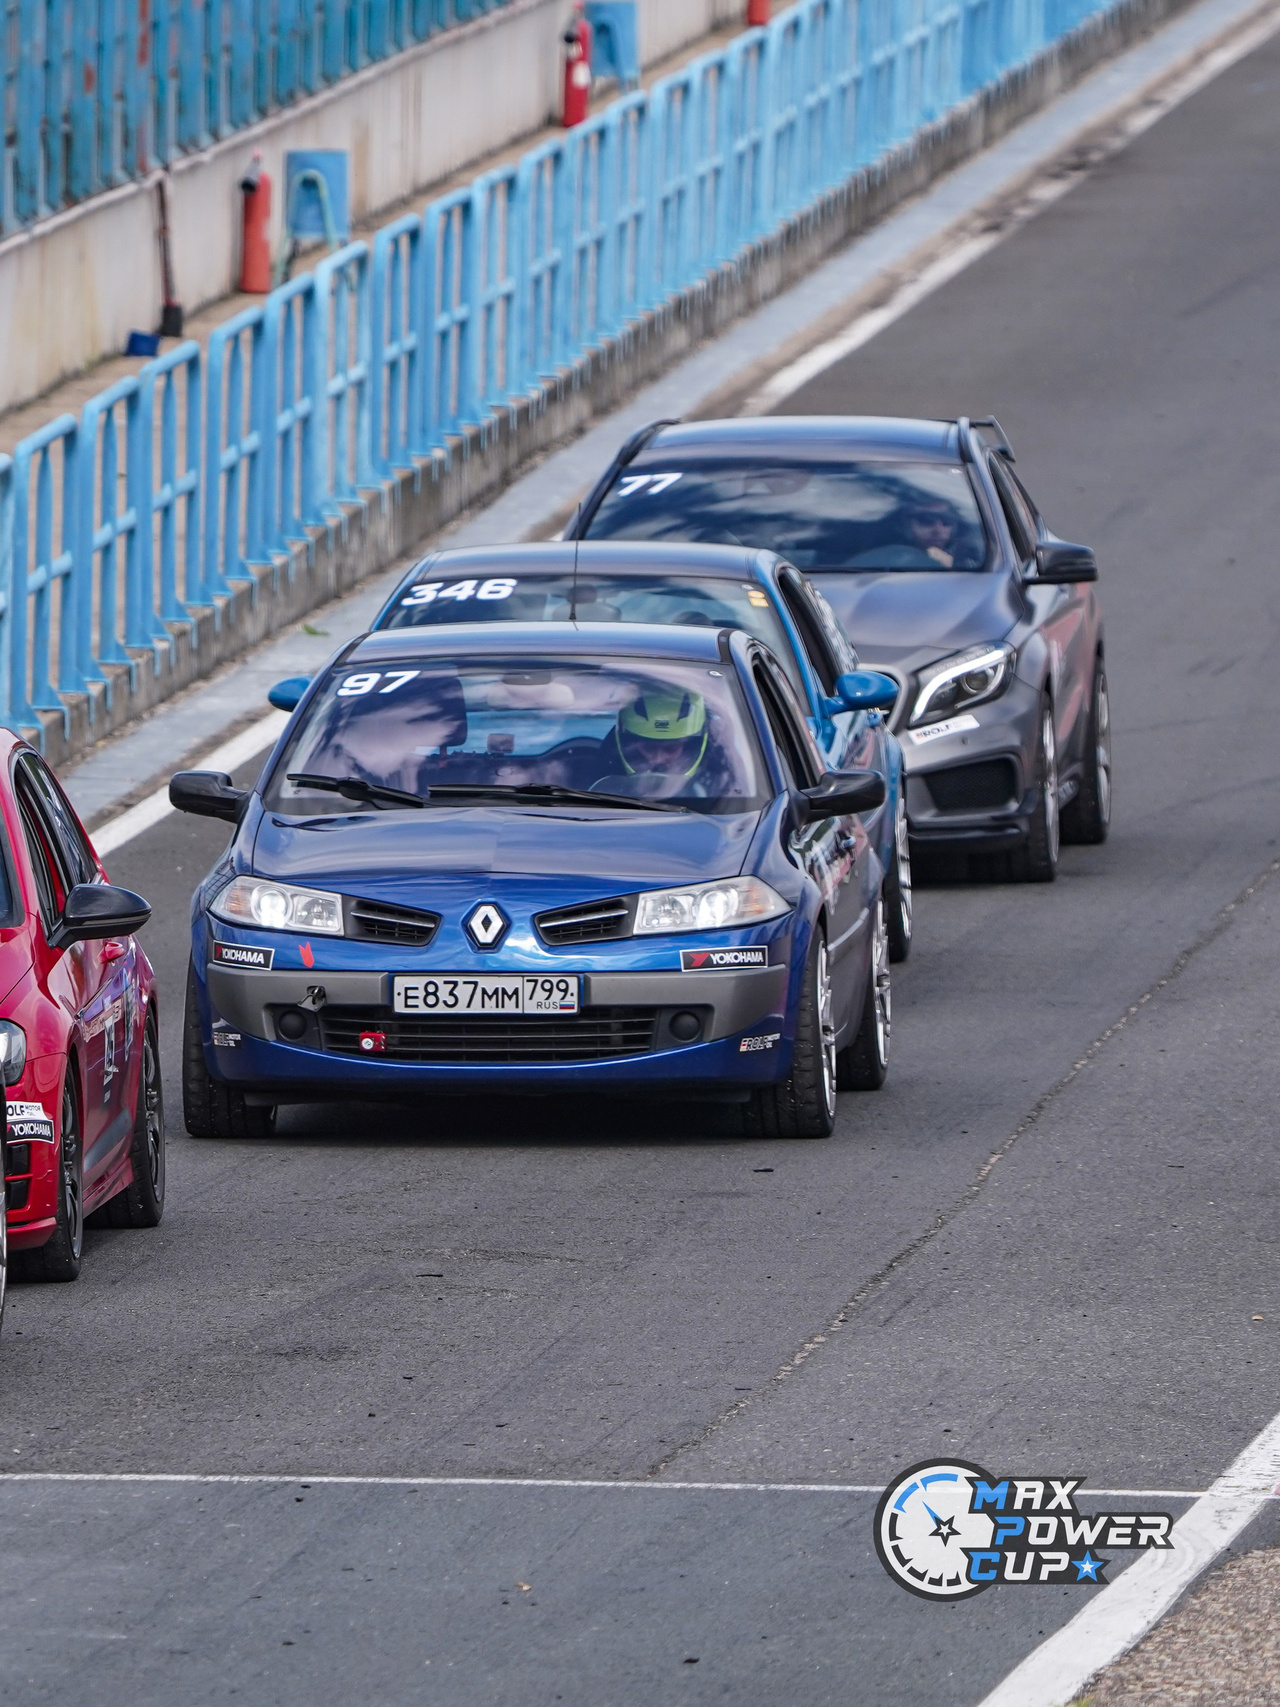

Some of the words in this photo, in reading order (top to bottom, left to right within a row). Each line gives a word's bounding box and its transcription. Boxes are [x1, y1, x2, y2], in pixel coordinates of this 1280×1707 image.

[617, 472, 683, 497] 77
[401, 578, 517, 606] 346
[337, 670, 421, 697] 97
[221, 948, 265, 964] YOKOHAMA
[709, 952, 764, 964] YOKOHAMA
[526, 979, 570, 1000] 799
[536, 1001, 558, 1009] RUS
[11, 1122, 51, 1137] YOKOHAMA
